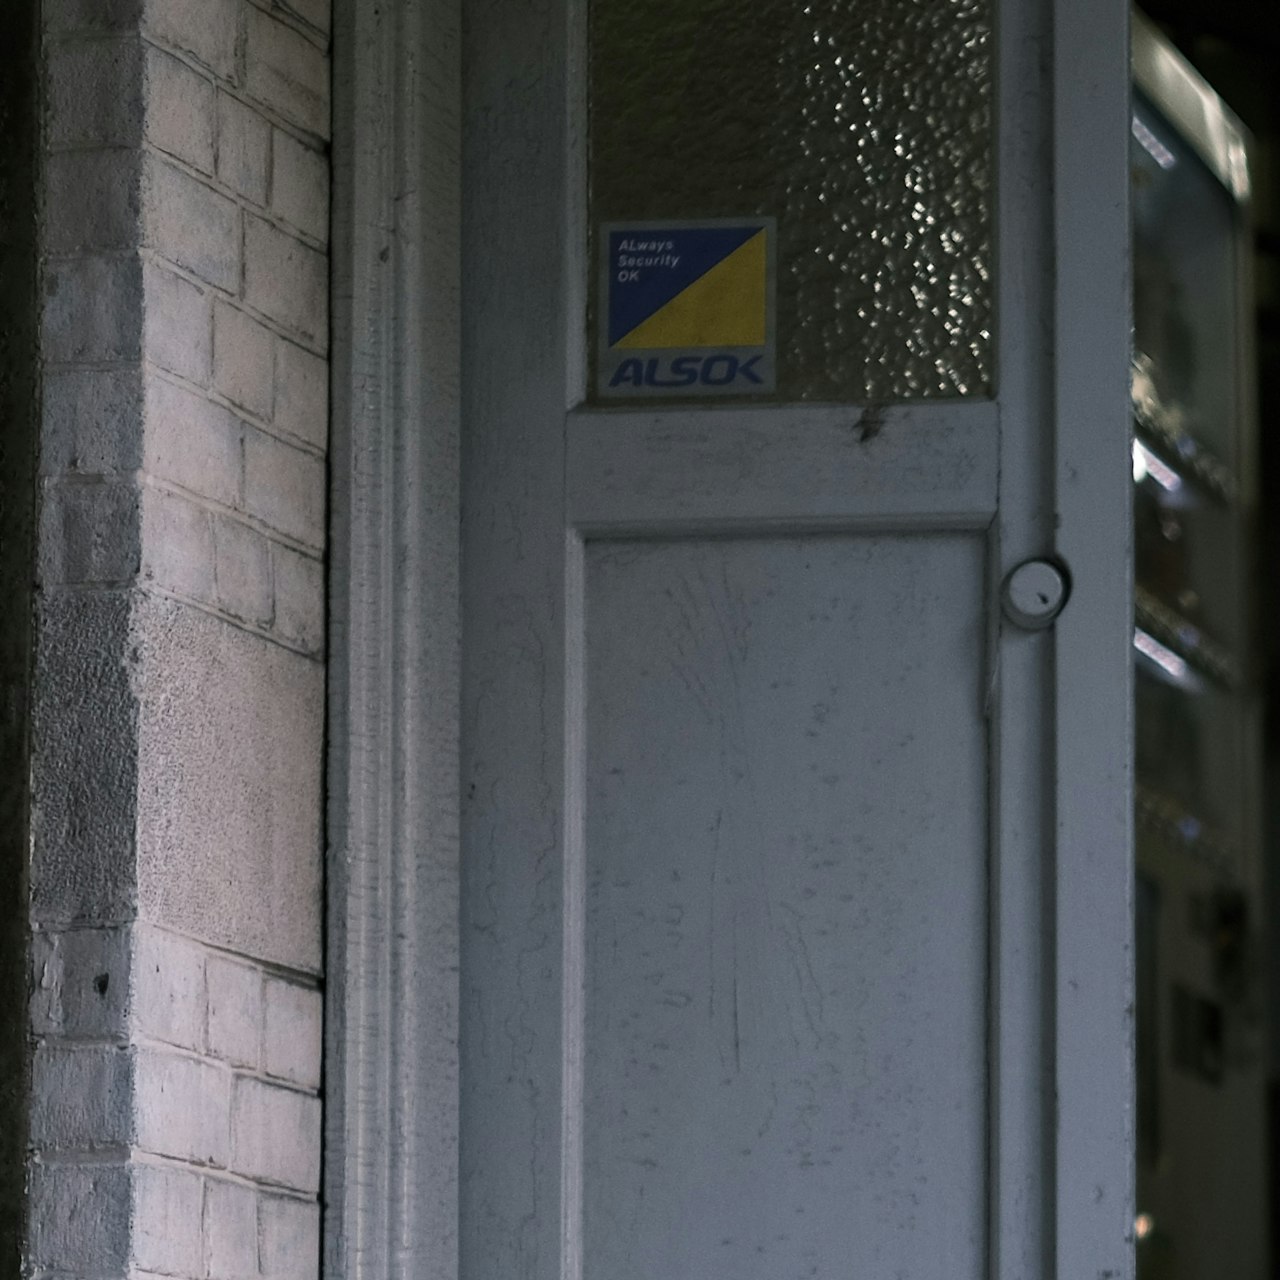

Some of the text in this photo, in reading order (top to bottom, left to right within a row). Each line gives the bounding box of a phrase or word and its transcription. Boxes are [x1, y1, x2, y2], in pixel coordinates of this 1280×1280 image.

[617, 254, 681, 270] Security
[617, 269, 640, 283] OK
[608, 354, 764, 388] ALSOK
